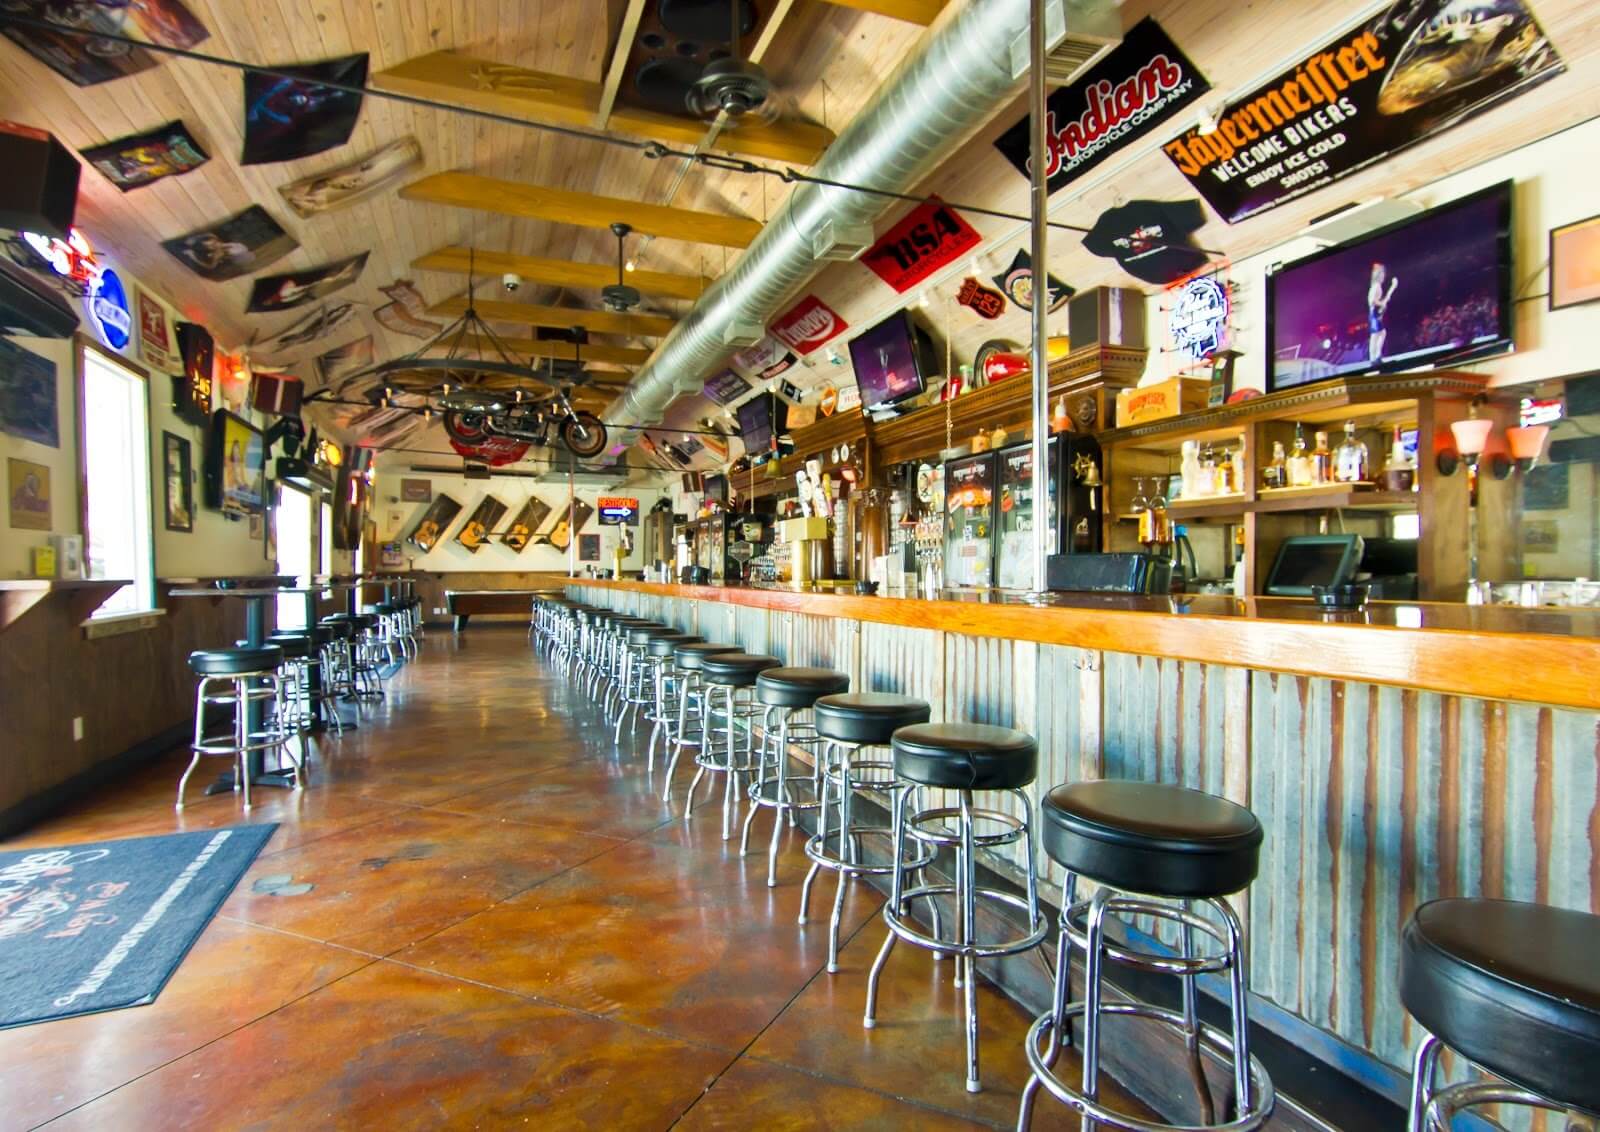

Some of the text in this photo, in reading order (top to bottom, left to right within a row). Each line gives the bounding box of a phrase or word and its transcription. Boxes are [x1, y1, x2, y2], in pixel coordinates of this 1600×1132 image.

[1026, 54, 1182, 178] Indian
[1062, 78, 1193, 172] MOTORCYCLE COMPANY
[1211, 97, 1358, 182] WELCOME BIKERS
[1245, 133, 1347, 188] ENJOY ICE COLD
[1279, 160, 1329, 189] SHOTS!
[891, 207, 962, 271] BSA
